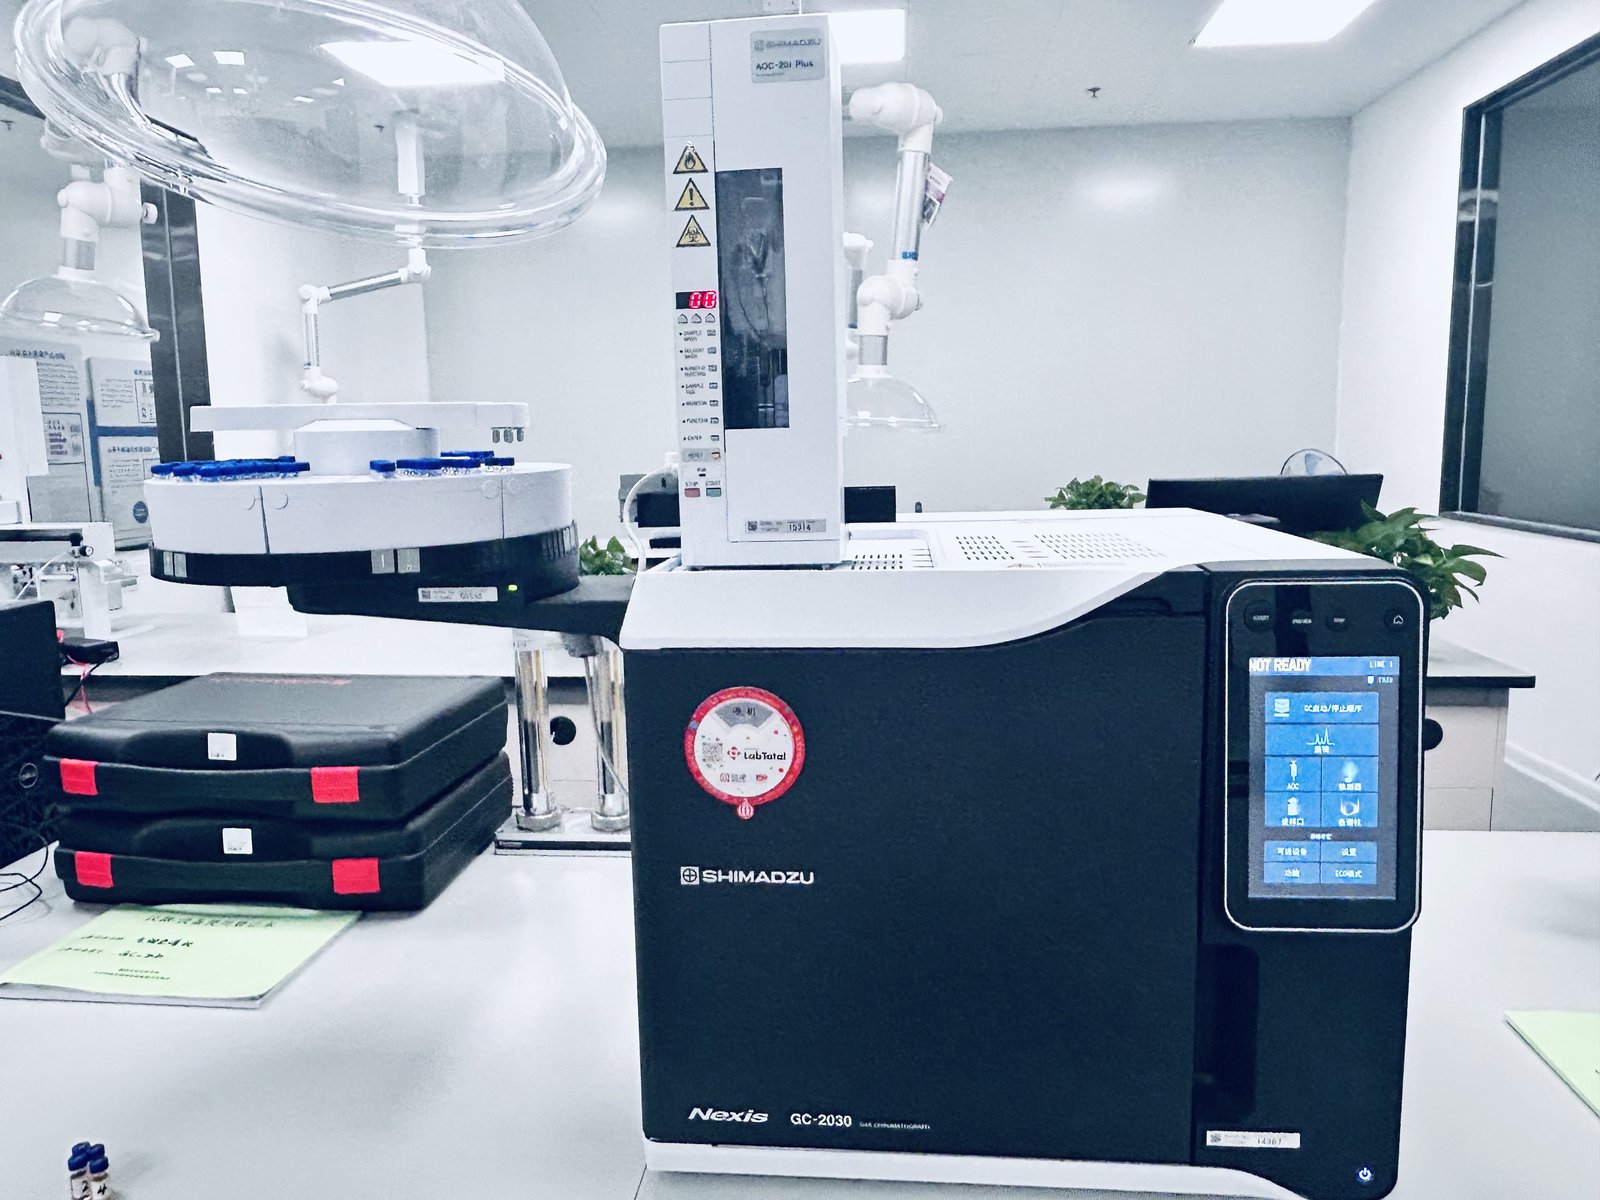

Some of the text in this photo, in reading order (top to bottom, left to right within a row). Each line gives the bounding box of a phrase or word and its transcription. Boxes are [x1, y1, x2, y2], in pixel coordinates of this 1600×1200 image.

[1249, 657, 1312, 672] NOT READY
[702, 869, 815, 885] SHIMADZU
[688, 1106, 769, 1124] Nexis
[790, 1112, 853, 1128] GC-2030
